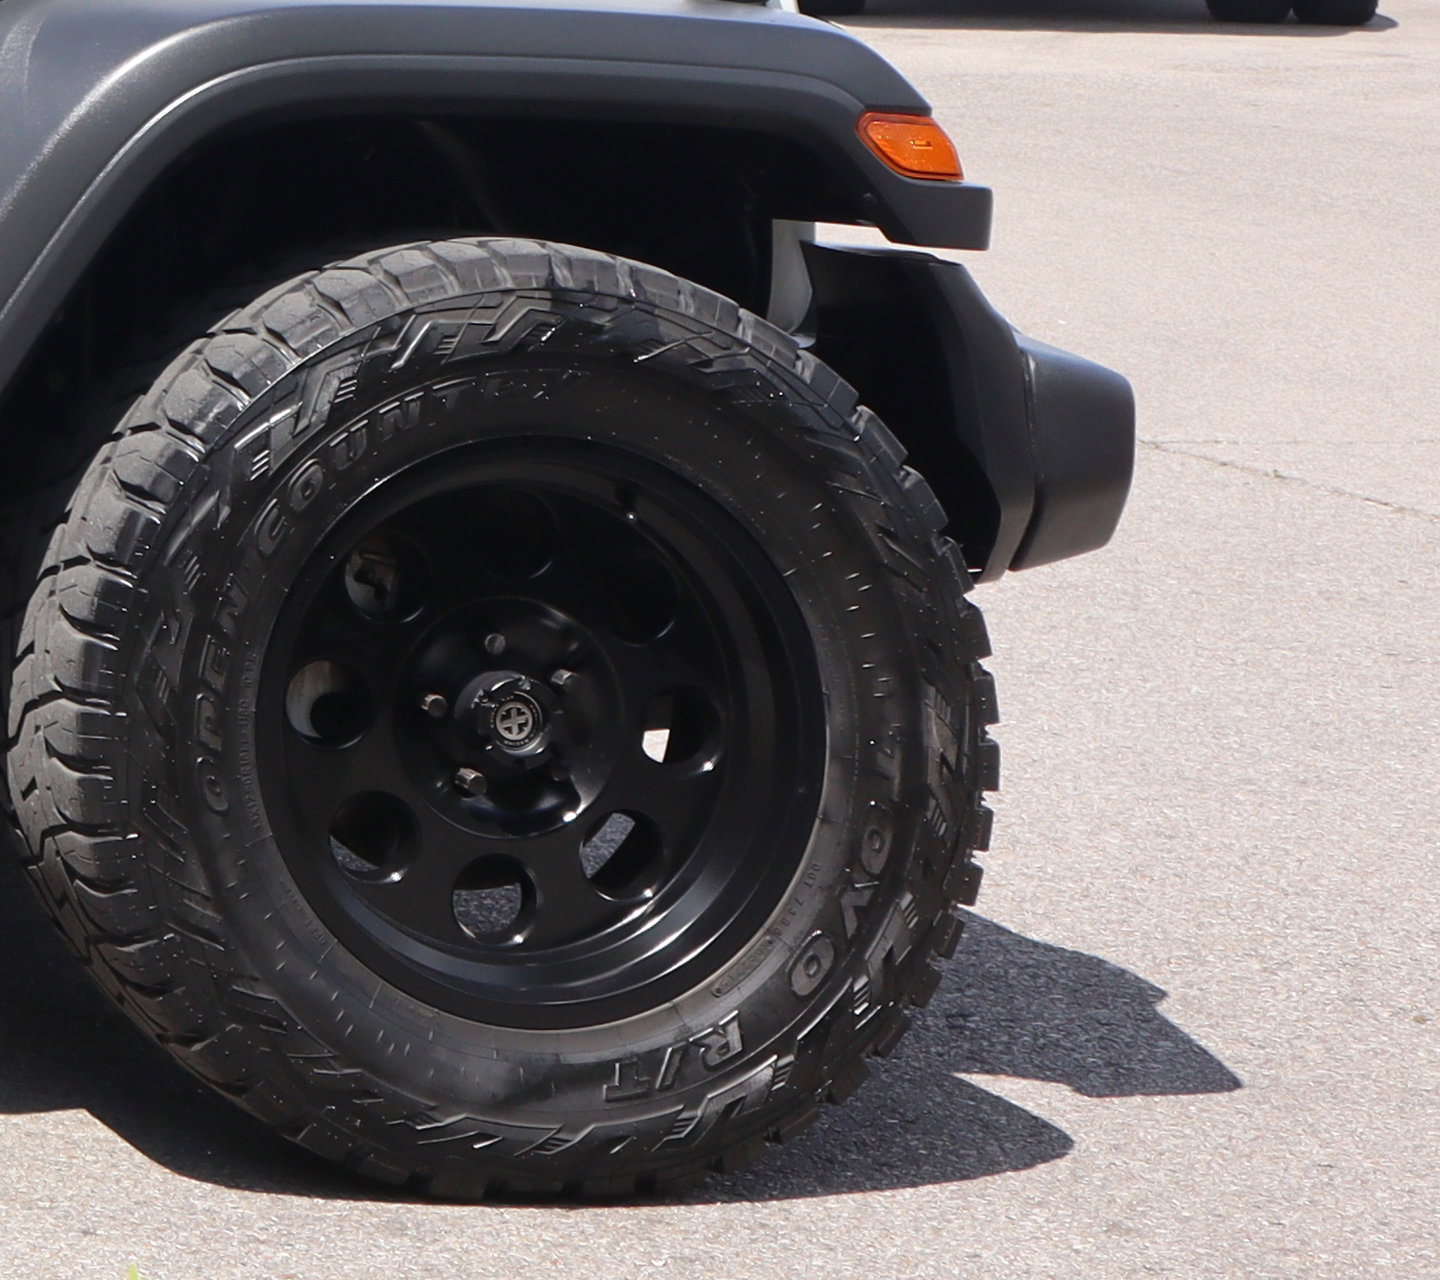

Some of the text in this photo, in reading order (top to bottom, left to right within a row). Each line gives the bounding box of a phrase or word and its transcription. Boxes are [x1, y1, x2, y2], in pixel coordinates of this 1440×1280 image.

[193, 582, 254, 815] OPEN
[784, 746, 905, 999] TOYO
[602, 1009, 746, 1103] R/T
